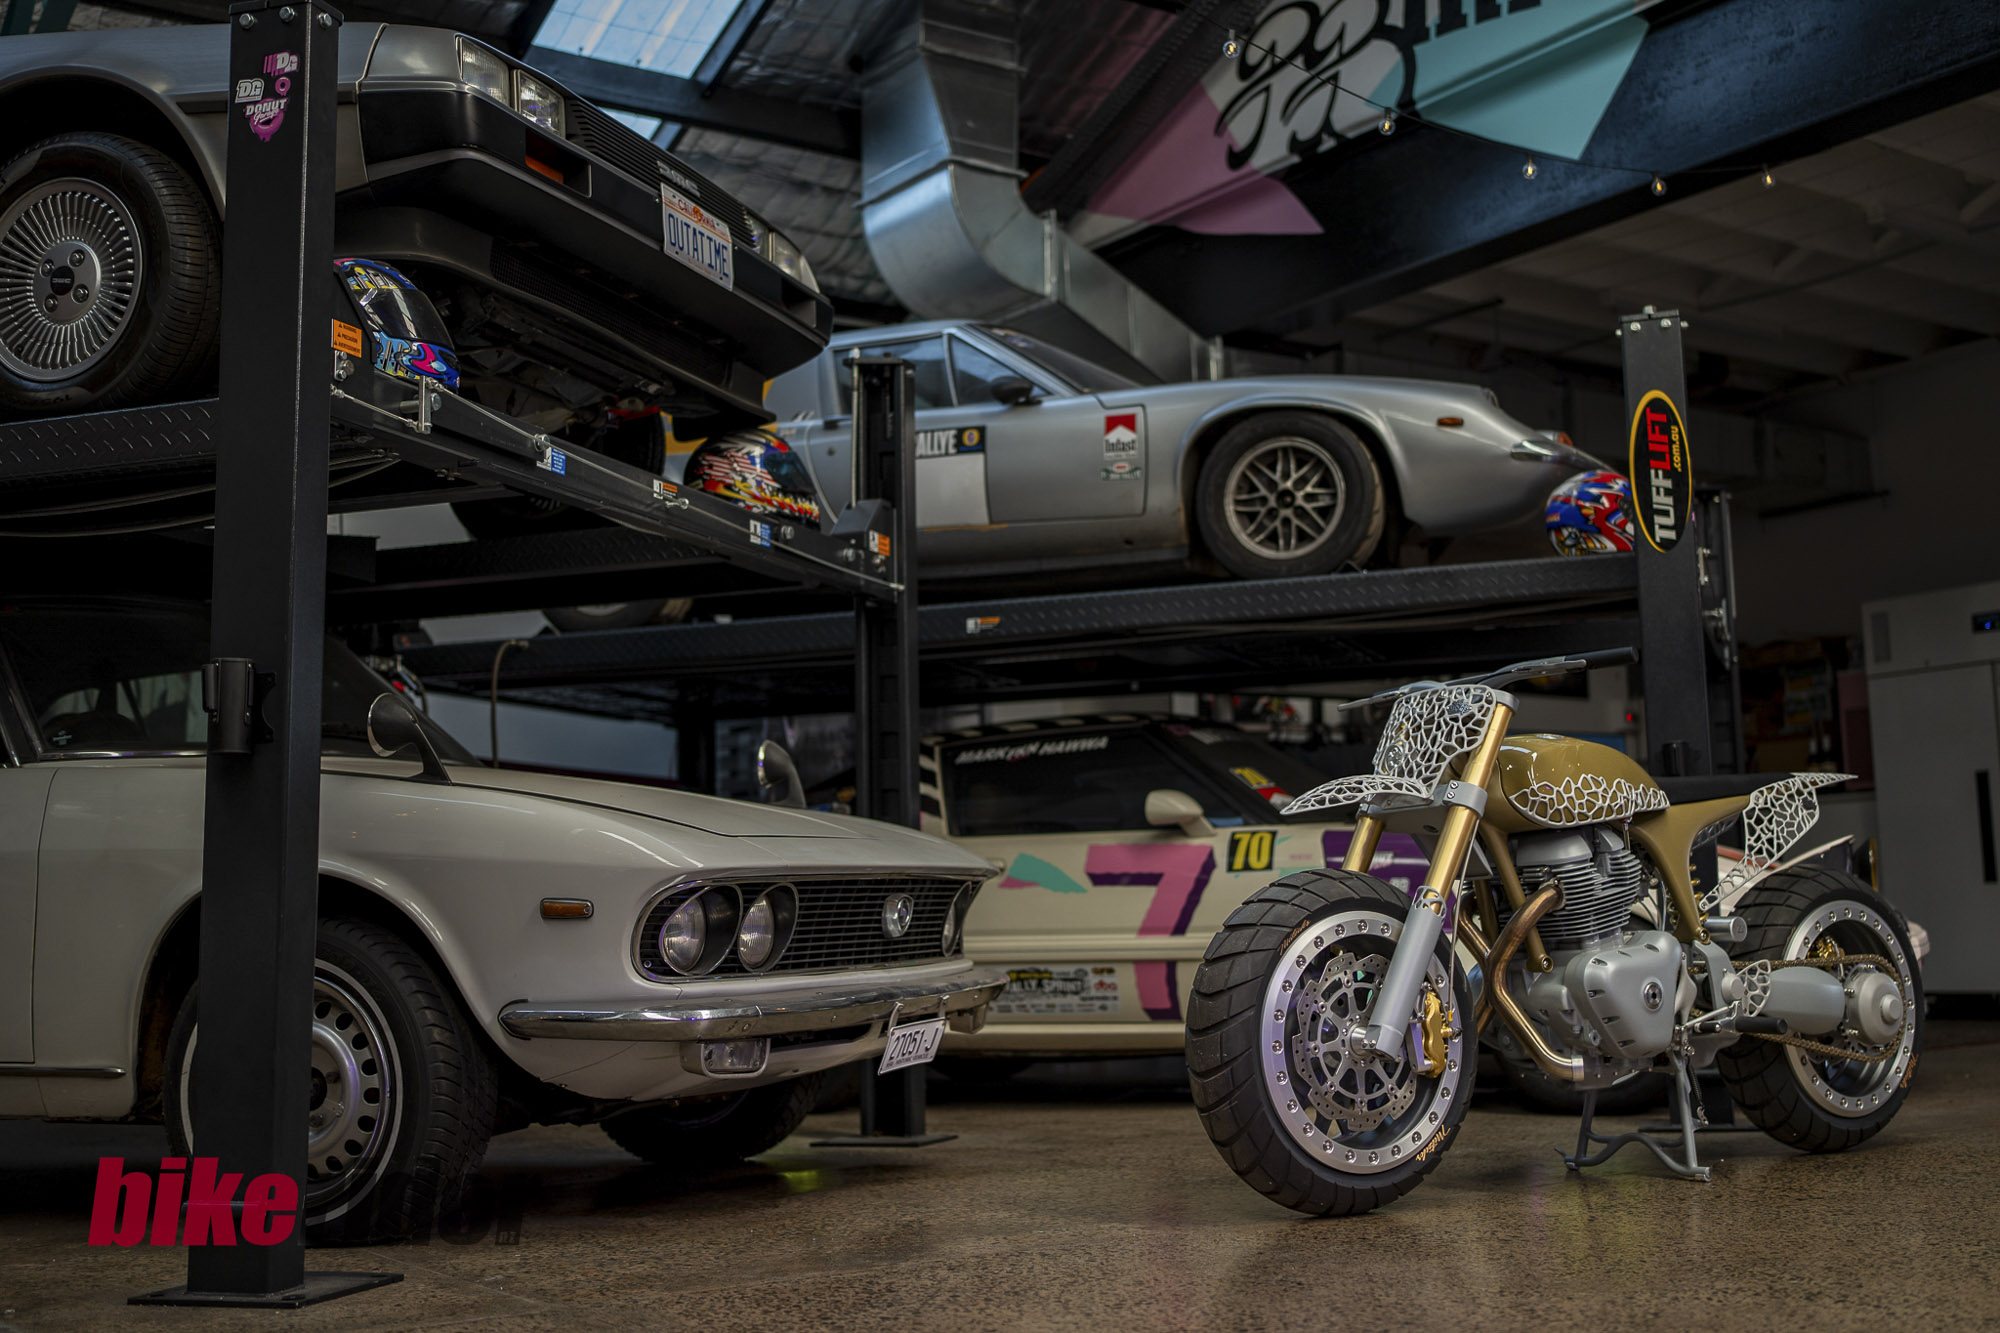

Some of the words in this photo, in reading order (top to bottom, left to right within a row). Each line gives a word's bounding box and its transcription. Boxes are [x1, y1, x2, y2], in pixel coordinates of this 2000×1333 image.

[276, 52, 298, 73] DG
[238, 81, 262, 98] DG
[246, 100, 288, 116] DONUT
[668, 212, 729, 278] OUTATIME
[915, 429, 958, 458] ALLYE
[1231, 832, 1273, 871] 70
